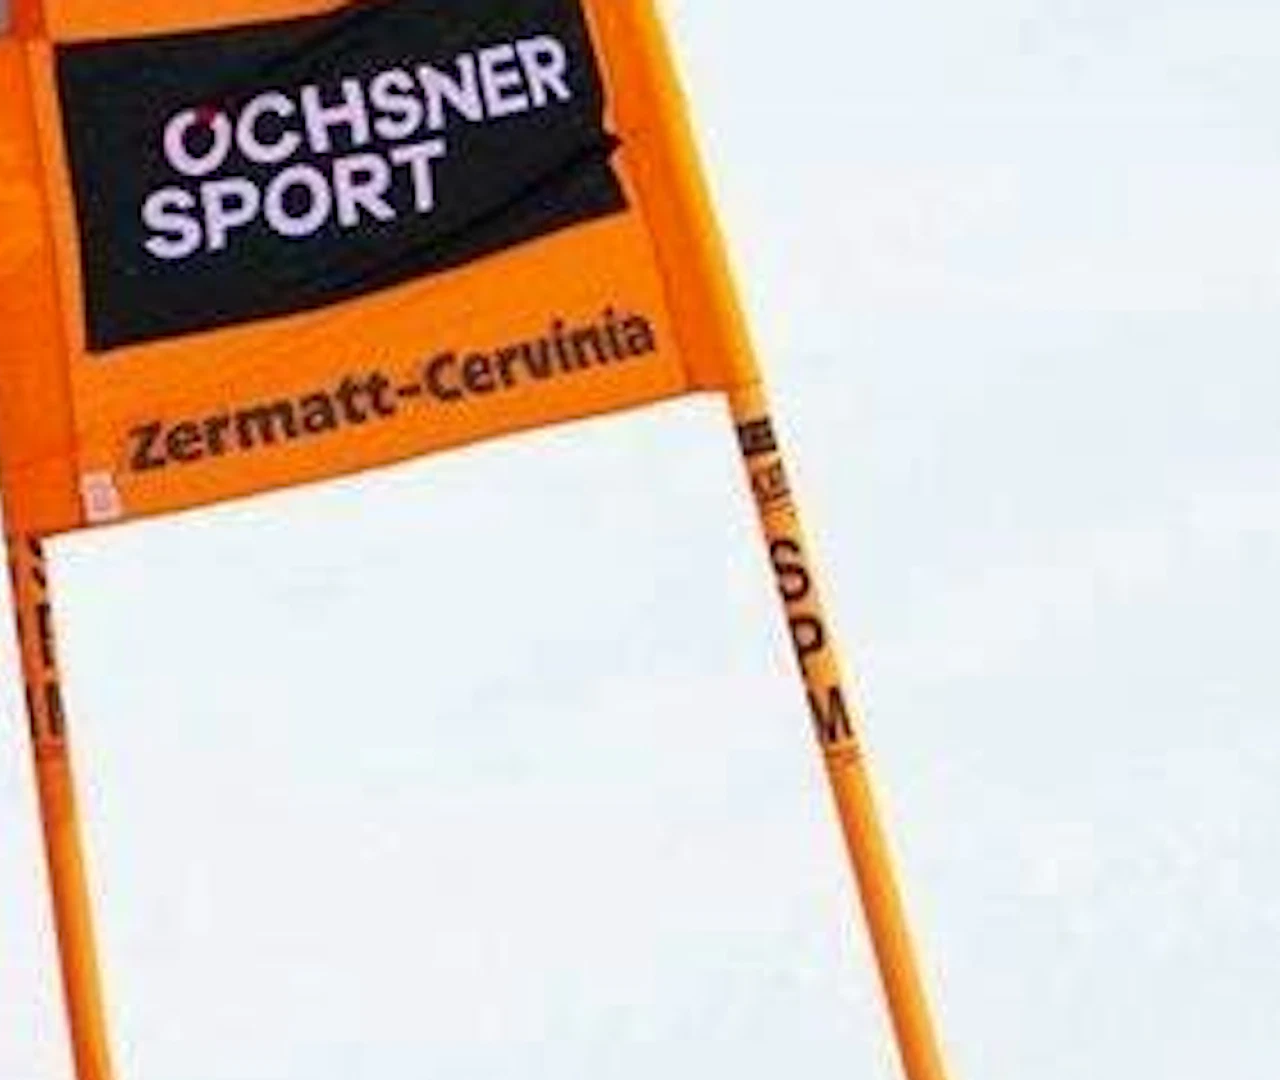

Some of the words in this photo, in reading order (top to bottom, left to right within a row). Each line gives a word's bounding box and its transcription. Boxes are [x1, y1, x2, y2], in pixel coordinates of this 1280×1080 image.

[162, 34, 571, 176] OCHSNER
[141, 138, 447, 259] SPORT
[125, 304, 658, 473] Zermatt-Cervinia
[769, 537, 856, 743] SPM
